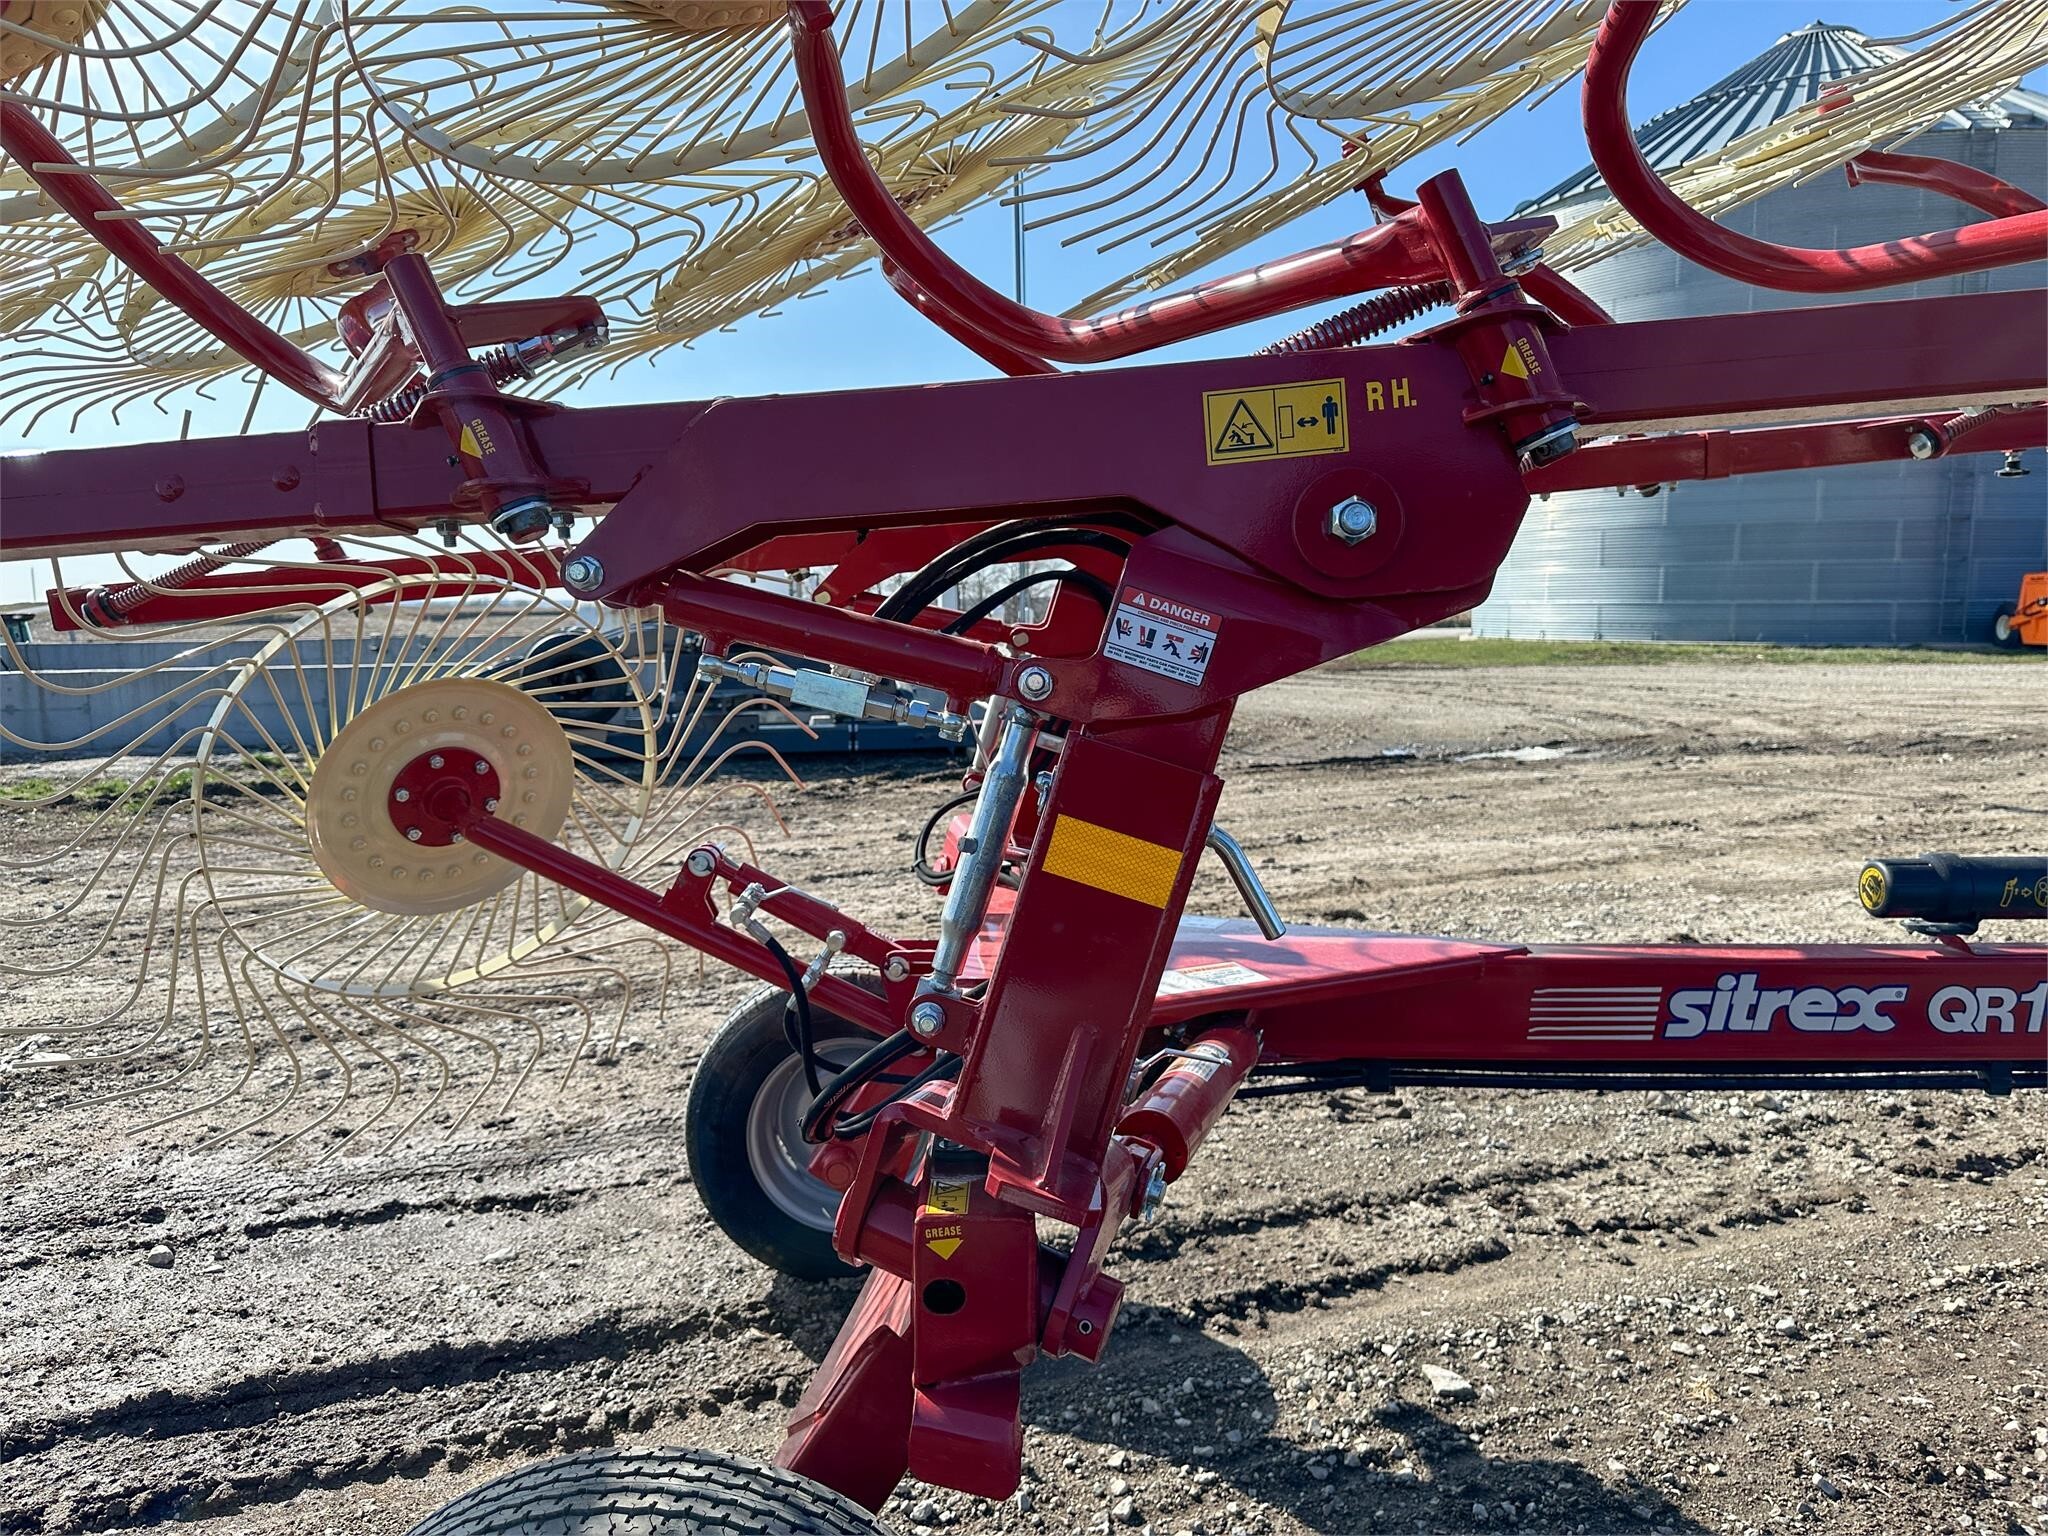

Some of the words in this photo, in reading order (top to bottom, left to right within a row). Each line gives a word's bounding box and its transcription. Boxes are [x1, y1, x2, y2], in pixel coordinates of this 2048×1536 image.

[1517, 337, 1542, 375] GREASE
[472, 419, 496, 454] GREASE
[1149, 597, 1210, 626] DANGER
[925, 1226, 962, 1238] GREASE
